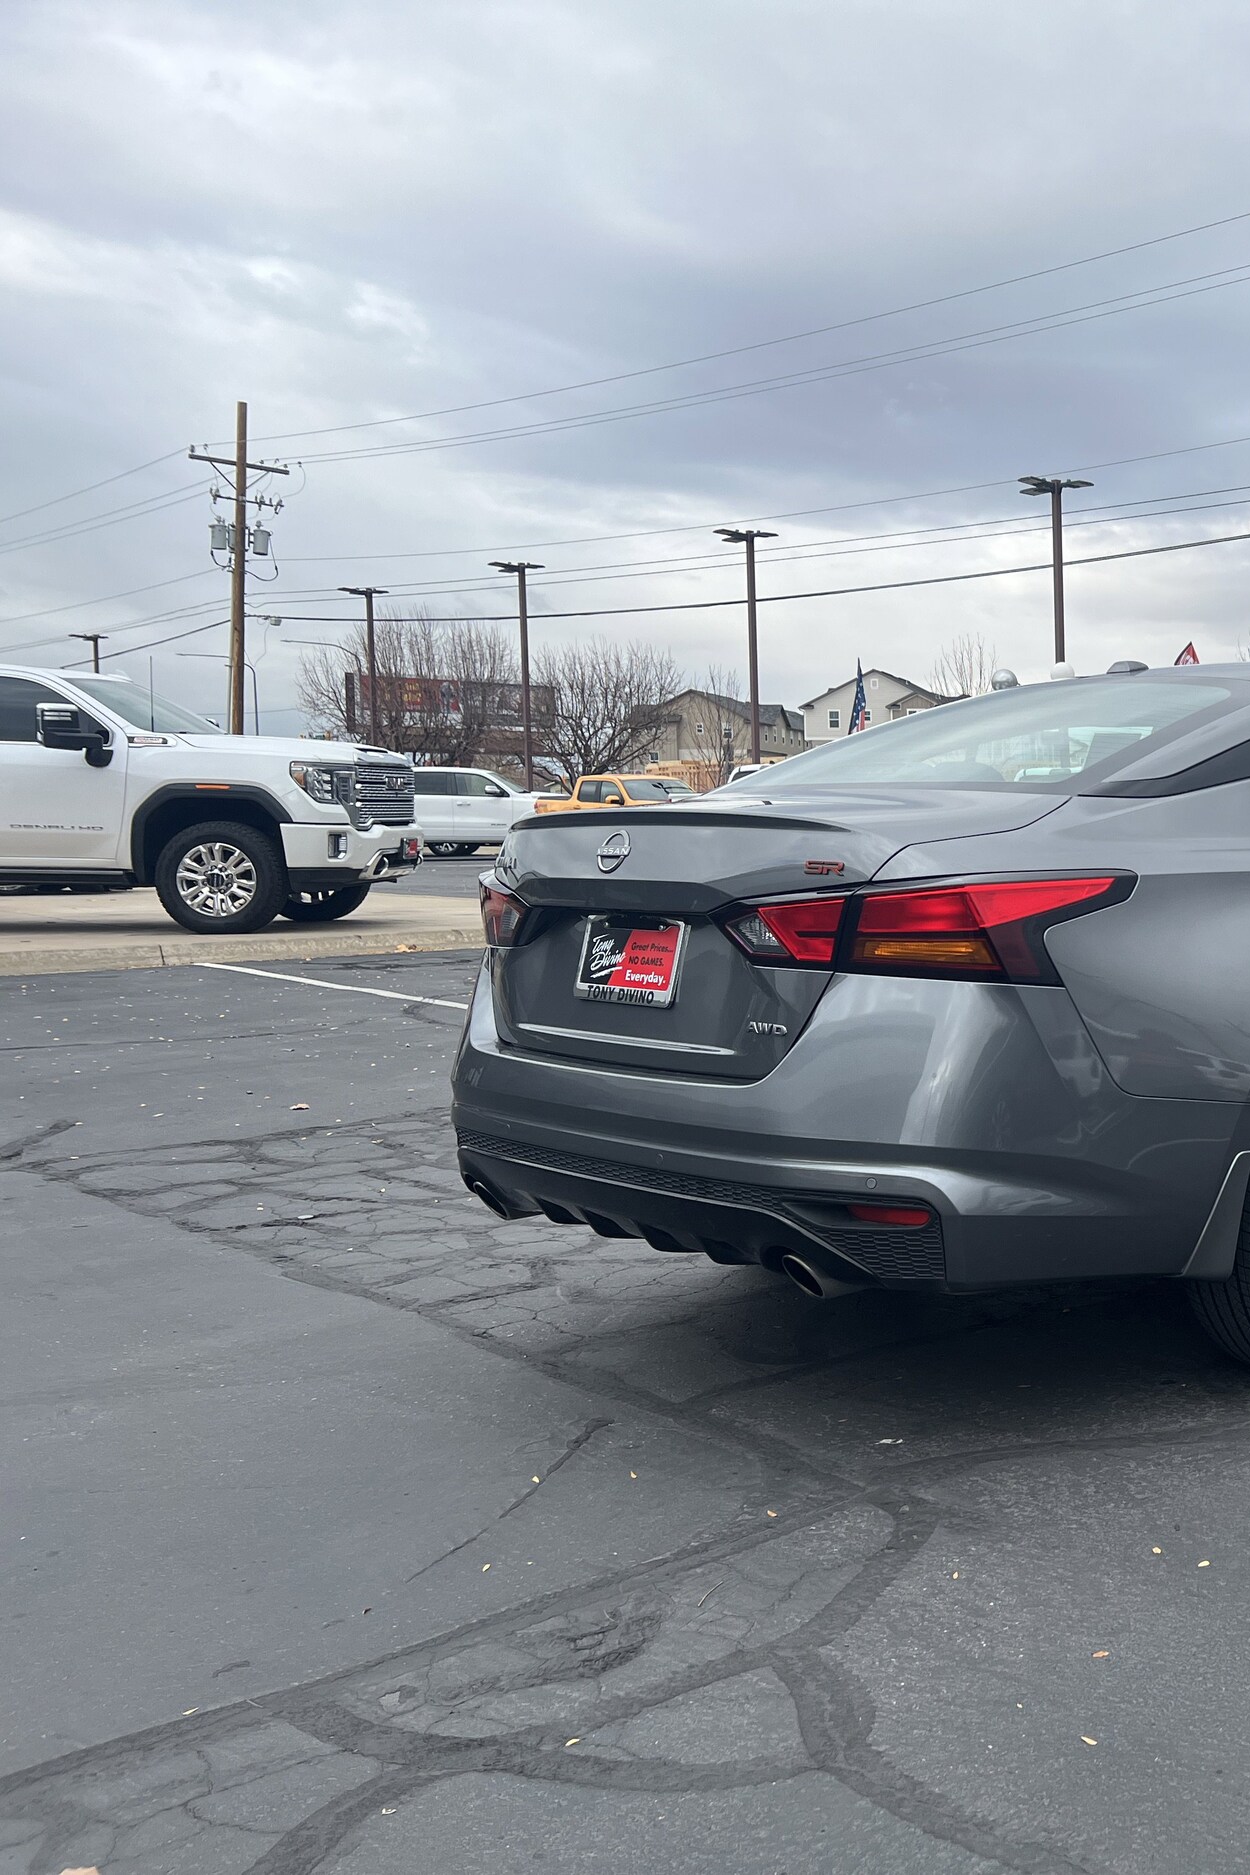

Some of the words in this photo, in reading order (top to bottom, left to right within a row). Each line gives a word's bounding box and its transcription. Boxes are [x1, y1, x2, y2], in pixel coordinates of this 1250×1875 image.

[804, 859, 845, 876] SR
[593, 933, 615, 955] Tony
[590, 950, 626, 971] Divino
[628, 955, 639, 965] NO
[625, 969, 666, 985] Everyday.
[587, 985, 615, 1000] TONY
[617, 988, 654, 1004] DIVINO
[747, 1021, 788, 1035] AWD
